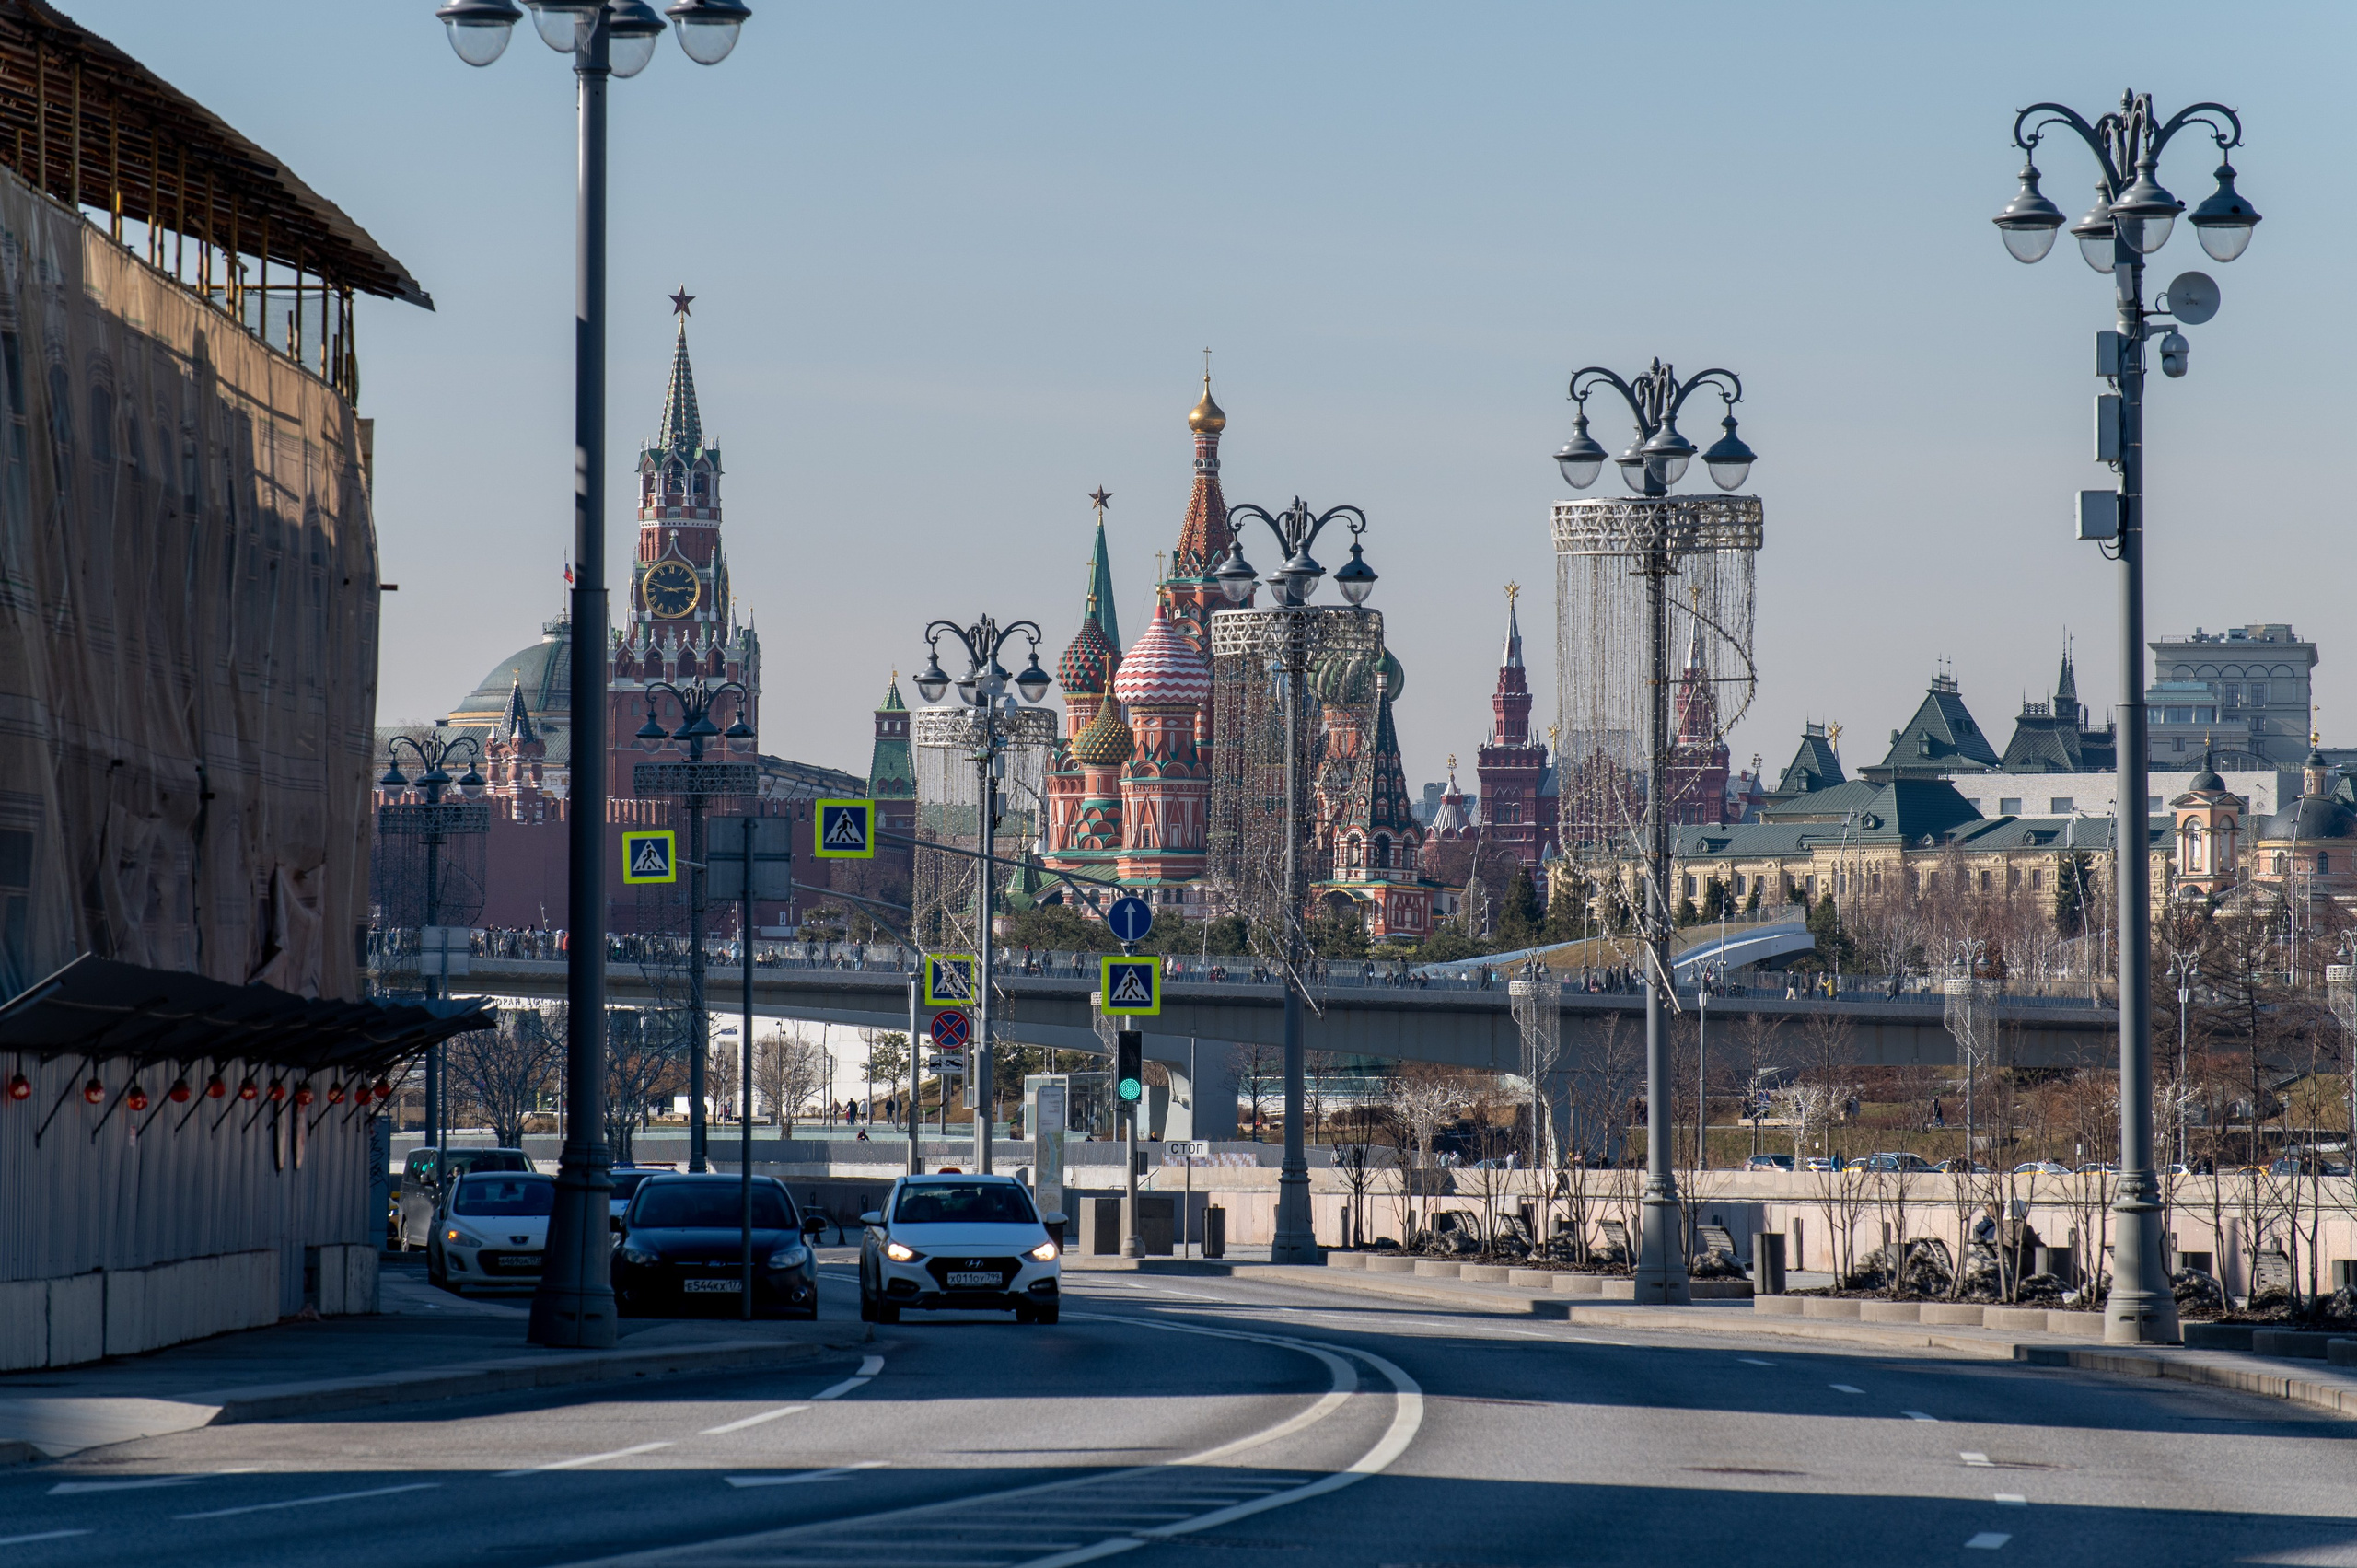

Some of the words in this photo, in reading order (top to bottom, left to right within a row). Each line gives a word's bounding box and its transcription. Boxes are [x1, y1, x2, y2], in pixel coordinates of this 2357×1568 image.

[1170, 1143, 1203, 1155] СТОП
[986, 1272, 1000, 1281] 799
[687, 1281, 726, 1291] Е544КХ
